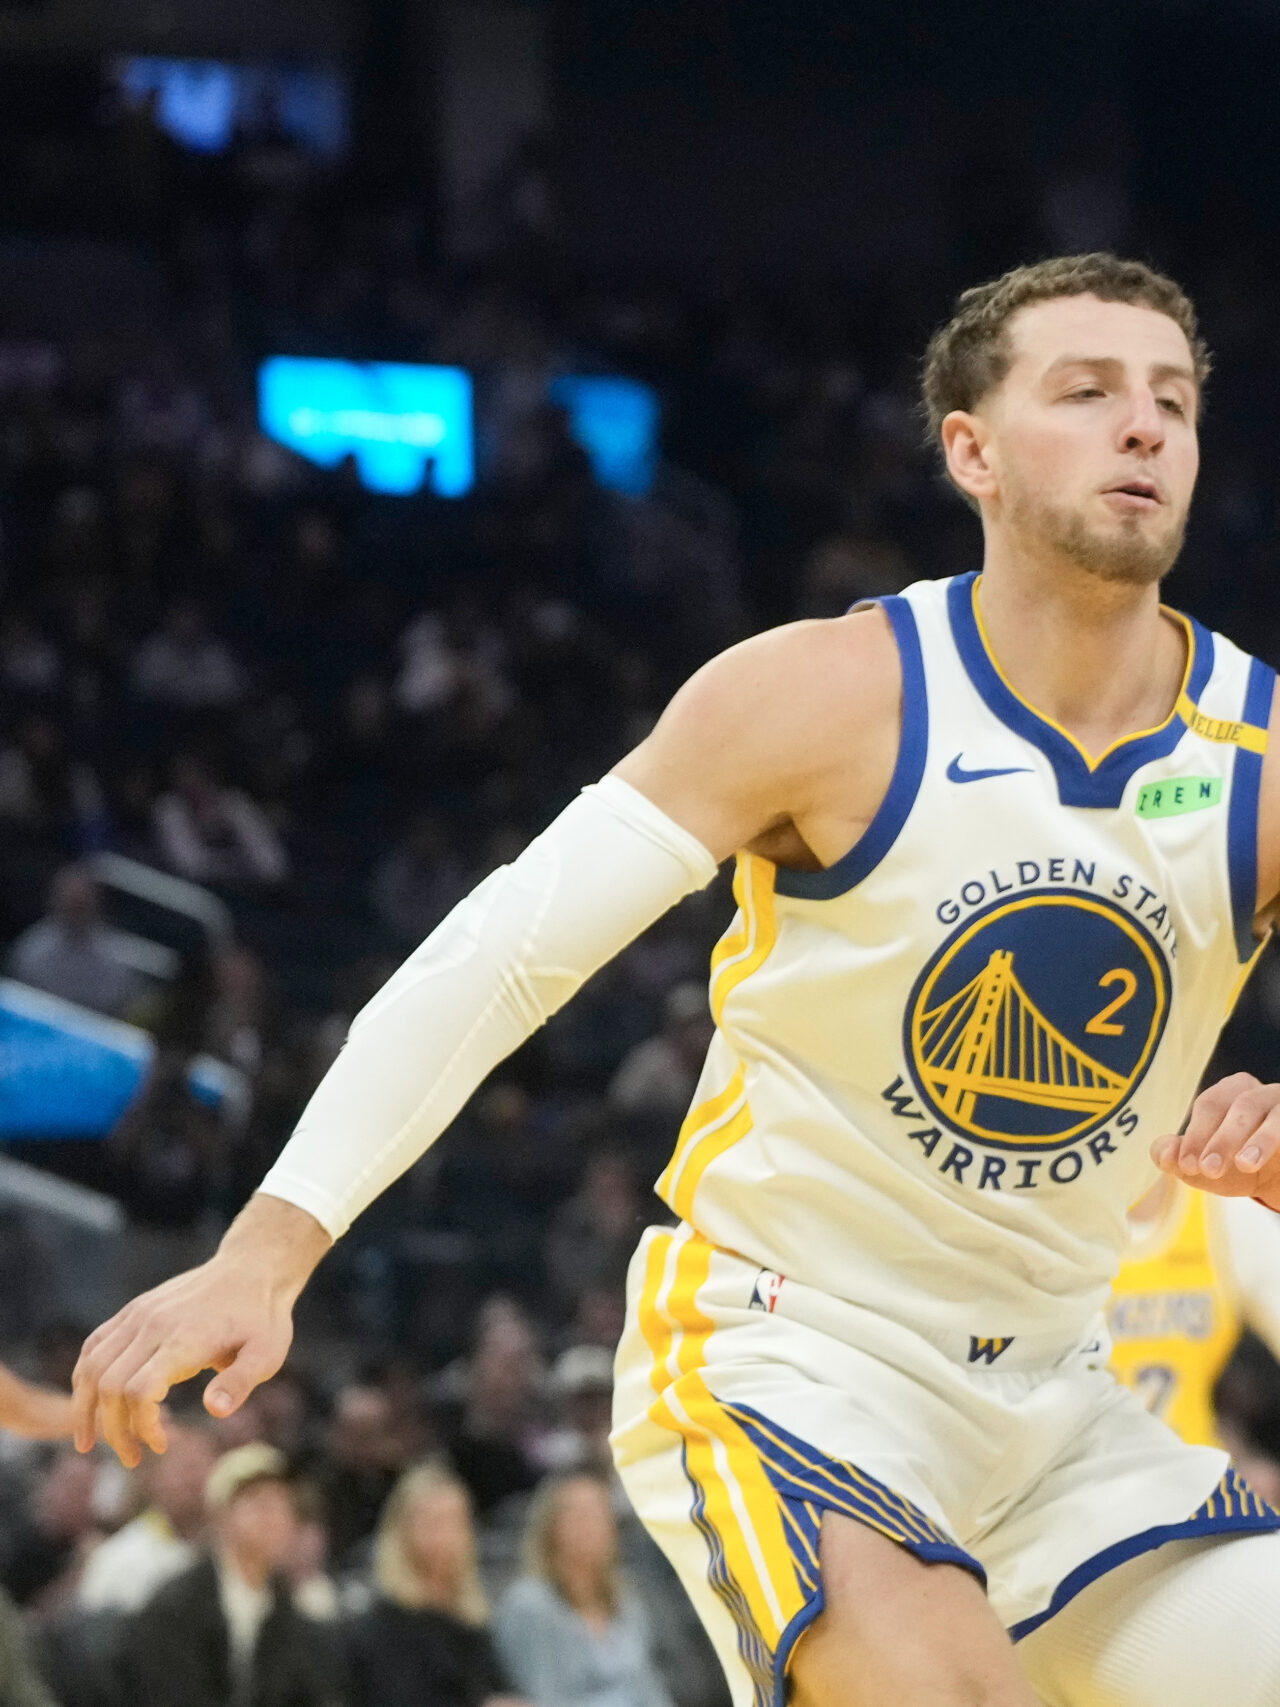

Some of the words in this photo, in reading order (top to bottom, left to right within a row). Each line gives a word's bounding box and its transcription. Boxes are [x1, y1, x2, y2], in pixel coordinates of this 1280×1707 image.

[1139, 782, 1211, 812] IREN
[936, 858, 1096, 926] GOLDEN
[1085, 967, 1137, 1036] 2
[881, 1074, 1139, 1191] WARRIORS
